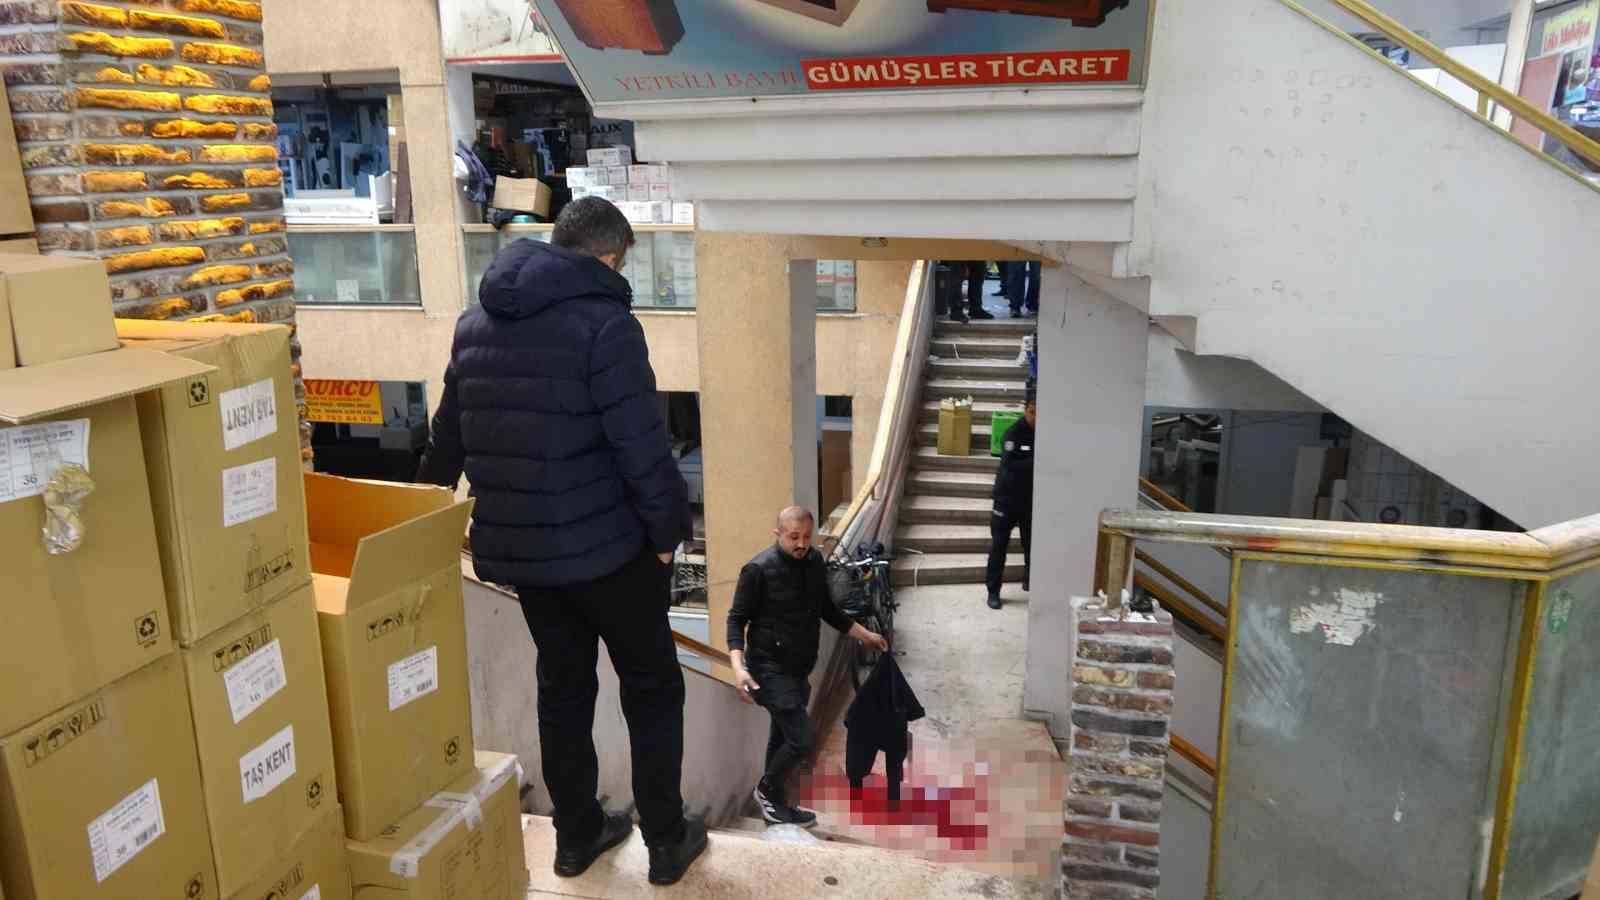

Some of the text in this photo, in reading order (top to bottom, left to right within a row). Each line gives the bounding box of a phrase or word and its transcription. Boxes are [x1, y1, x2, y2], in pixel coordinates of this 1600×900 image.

[807, 56, 1120, 84] GÜMÜŞLER TİCARET
[227, 403, 255, 431] KENT
[243, 742, 292, 791] TAŞ KENT
